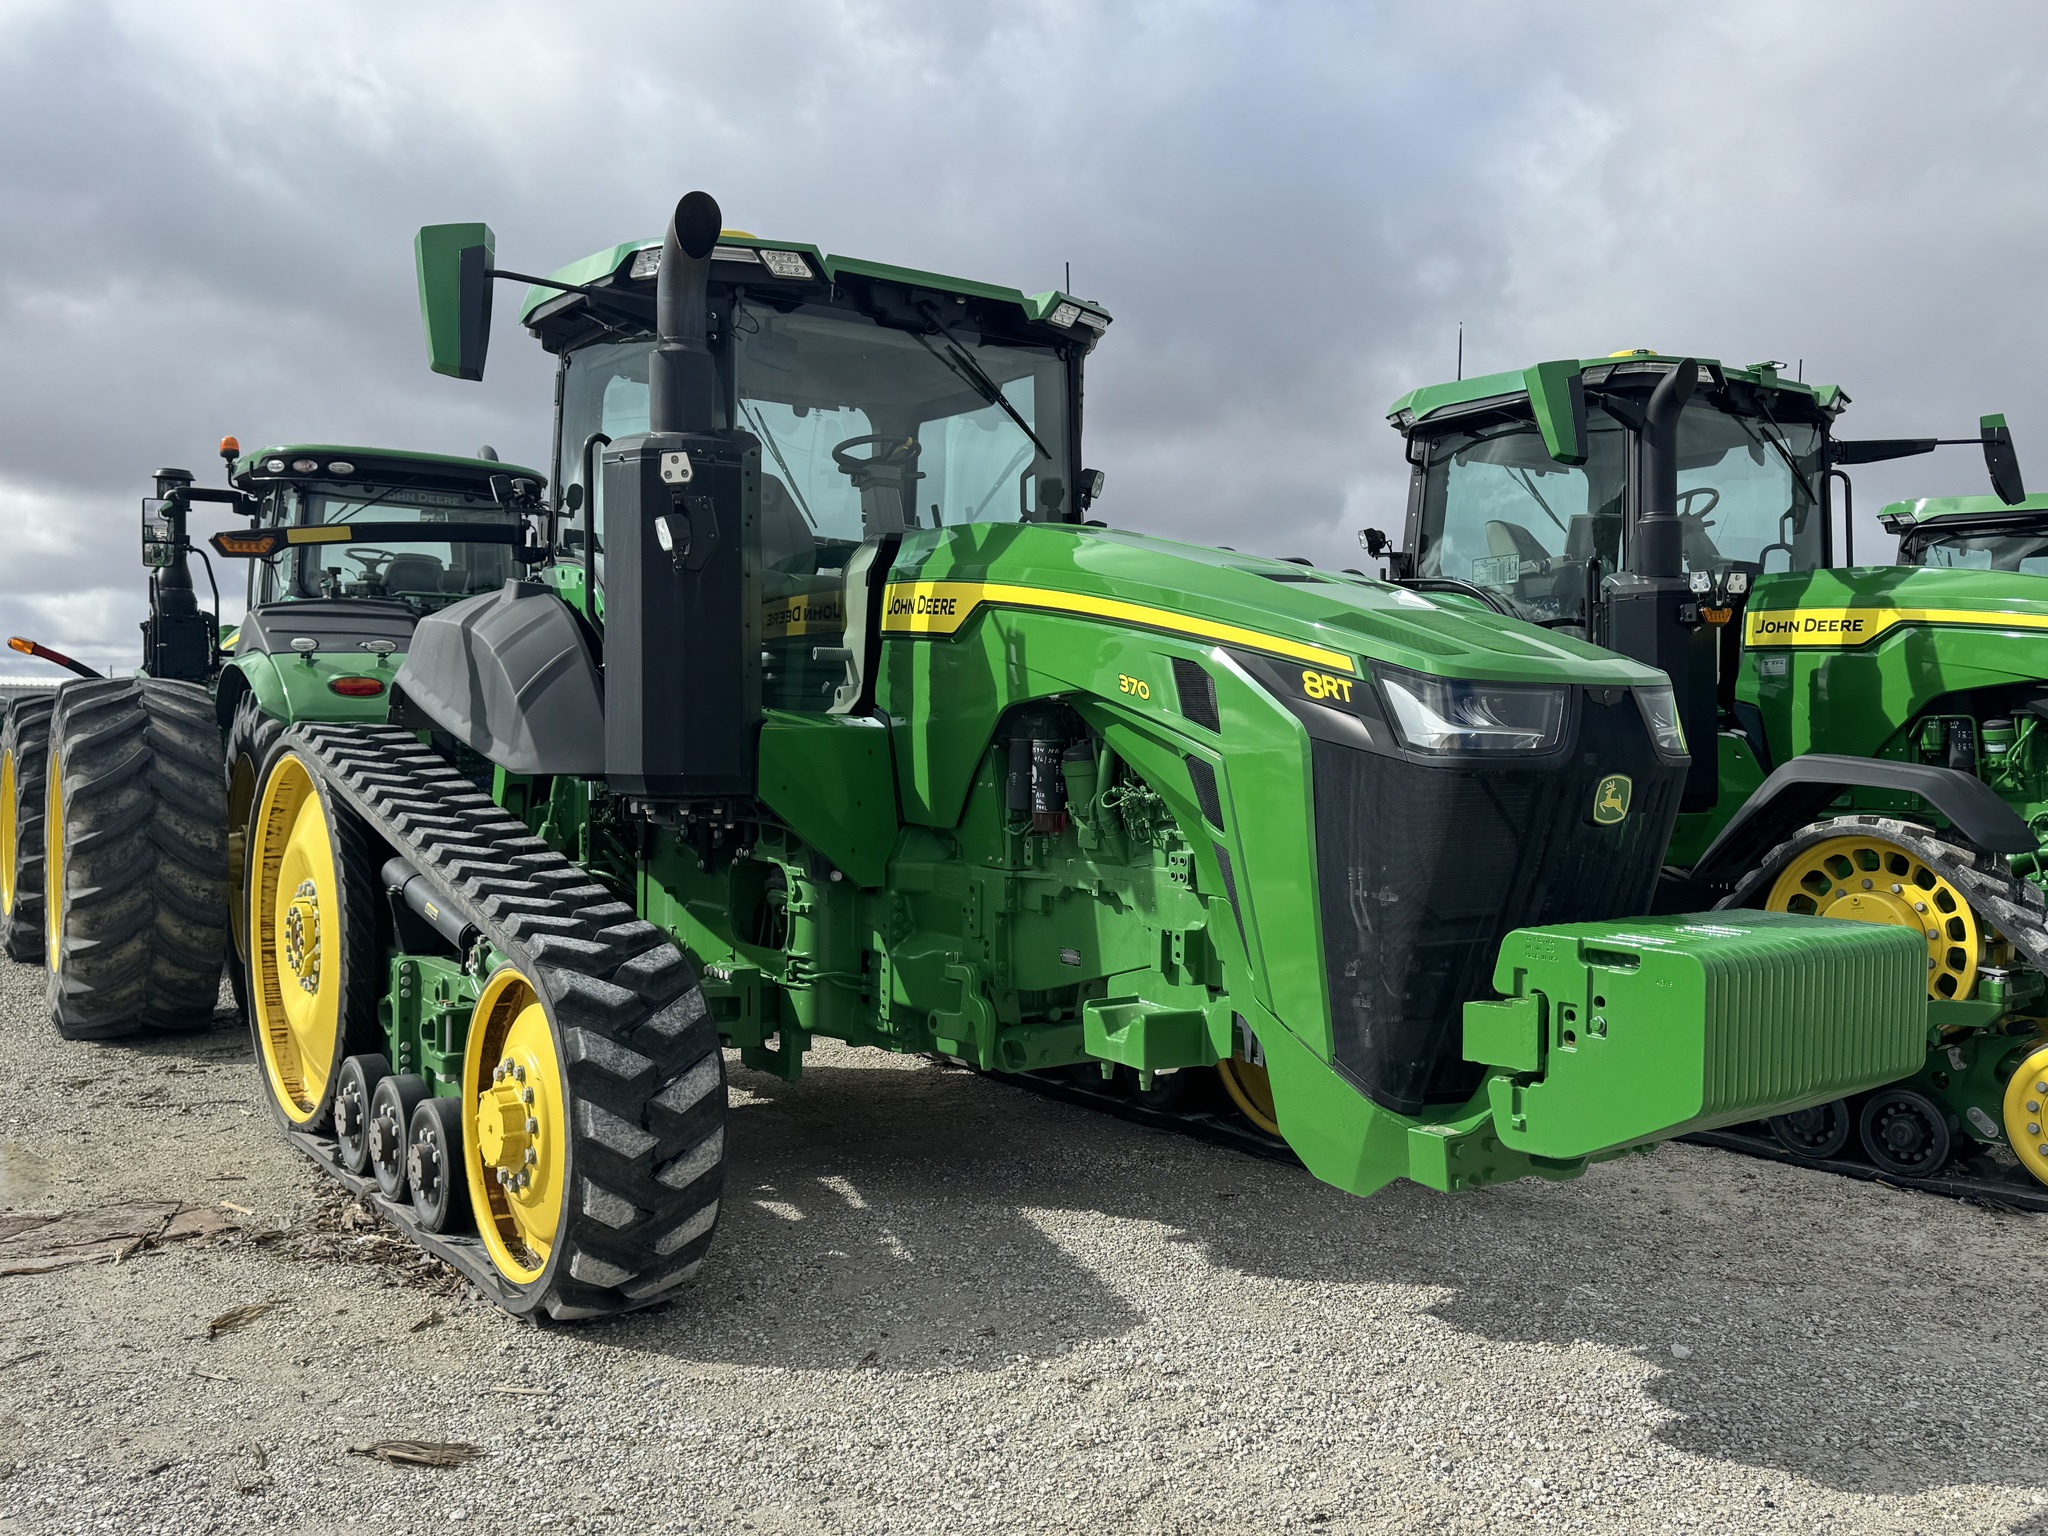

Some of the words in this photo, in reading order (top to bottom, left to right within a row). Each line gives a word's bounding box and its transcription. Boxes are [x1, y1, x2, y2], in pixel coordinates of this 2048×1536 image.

[384, 491, 415, 501] OHN
[418, 493, 460, 506] DEERE
[887, 596, 915, 615] JOHN
[917, 595, 957, 616] DEERE
[1755, 619, 1800, 634] JOHN
[1804, 618, 1864, 633] DEERE
[1118, 673, 1150, 700] 370
[1302, 670, 1353, 703] 8RT
